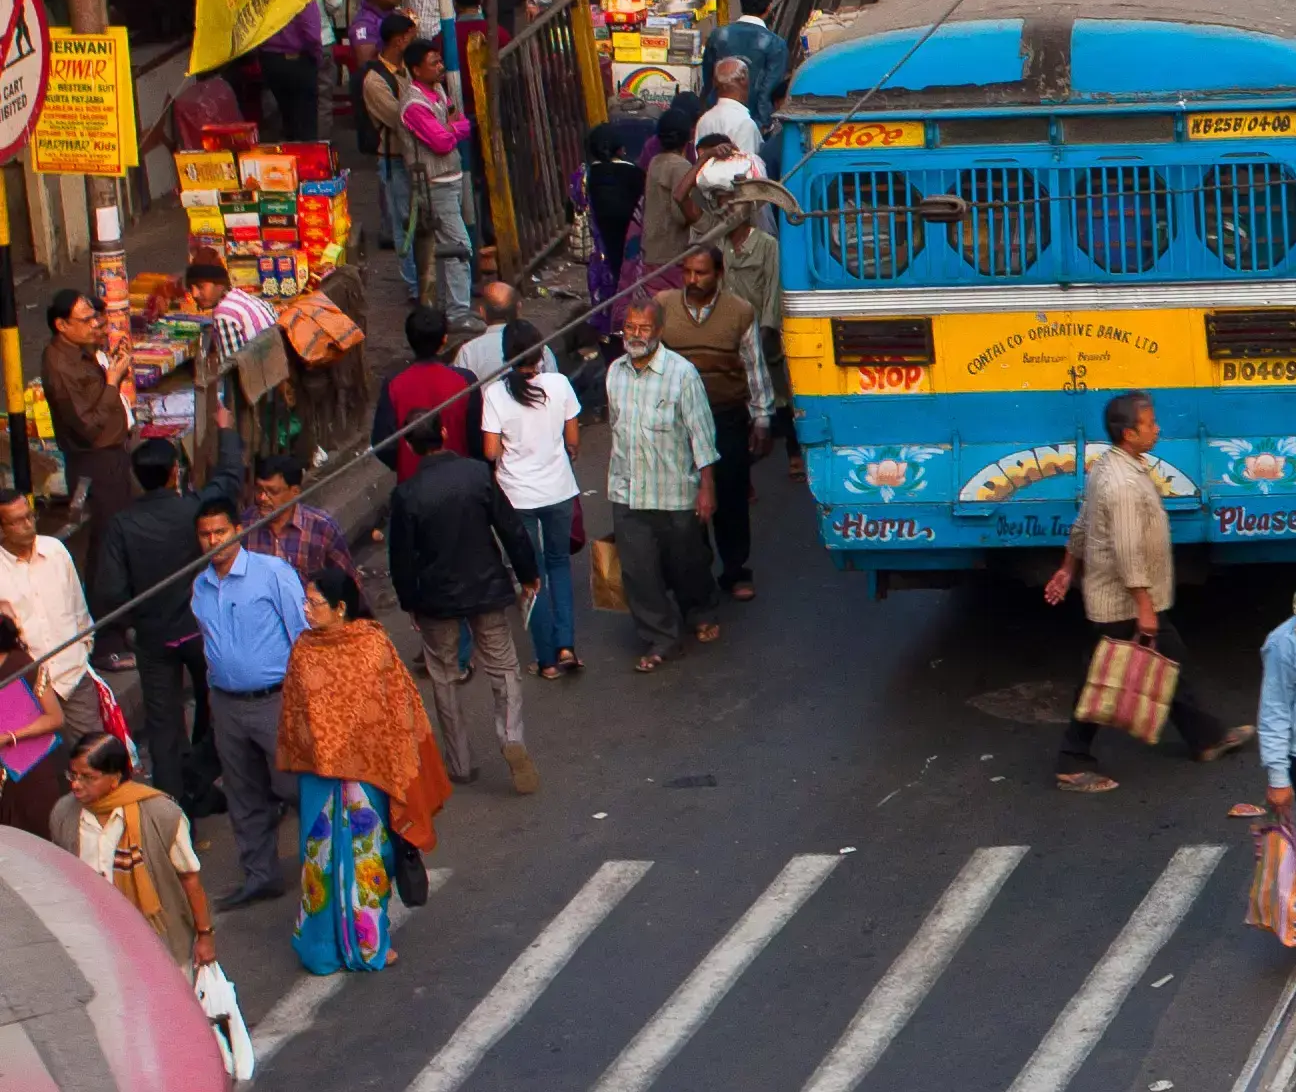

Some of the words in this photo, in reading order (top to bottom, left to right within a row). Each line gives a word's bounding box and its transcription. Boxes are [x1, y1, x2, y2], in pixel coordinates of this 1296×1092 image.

[3, 76, 24, 100] CART
[93, 140, 116, 151] Kids
[967, 339, 1006, 376] CONTAI
[1097, 323, 1130, 344] BANK
[1134, 334, 1159, 355] LTD
[834, 512, 935, 542] Horn
